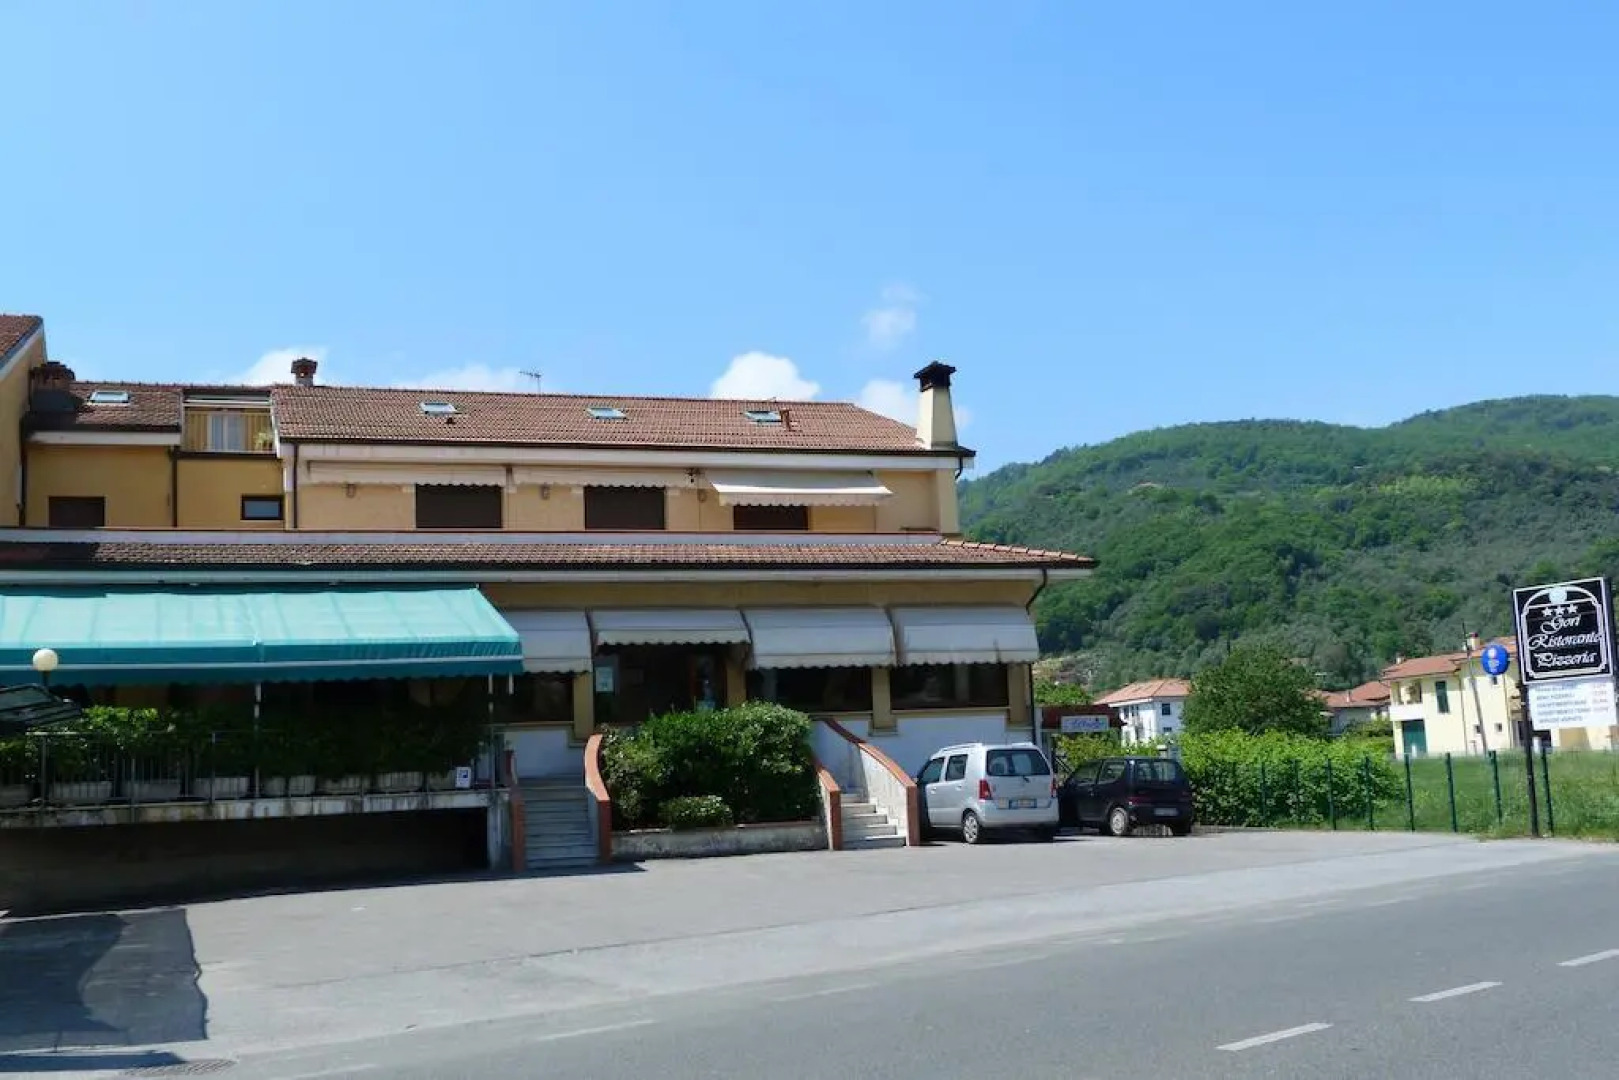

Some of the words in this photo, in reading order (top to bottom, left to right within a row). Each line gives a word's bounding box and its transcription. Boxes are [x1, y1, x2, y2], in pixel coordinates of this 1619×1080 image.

[1540, 614, 1581, 634] Gori
[1528, 632, 1602, 650] Ristorante
[1533, 651, 1597, 667] Pizzeria
